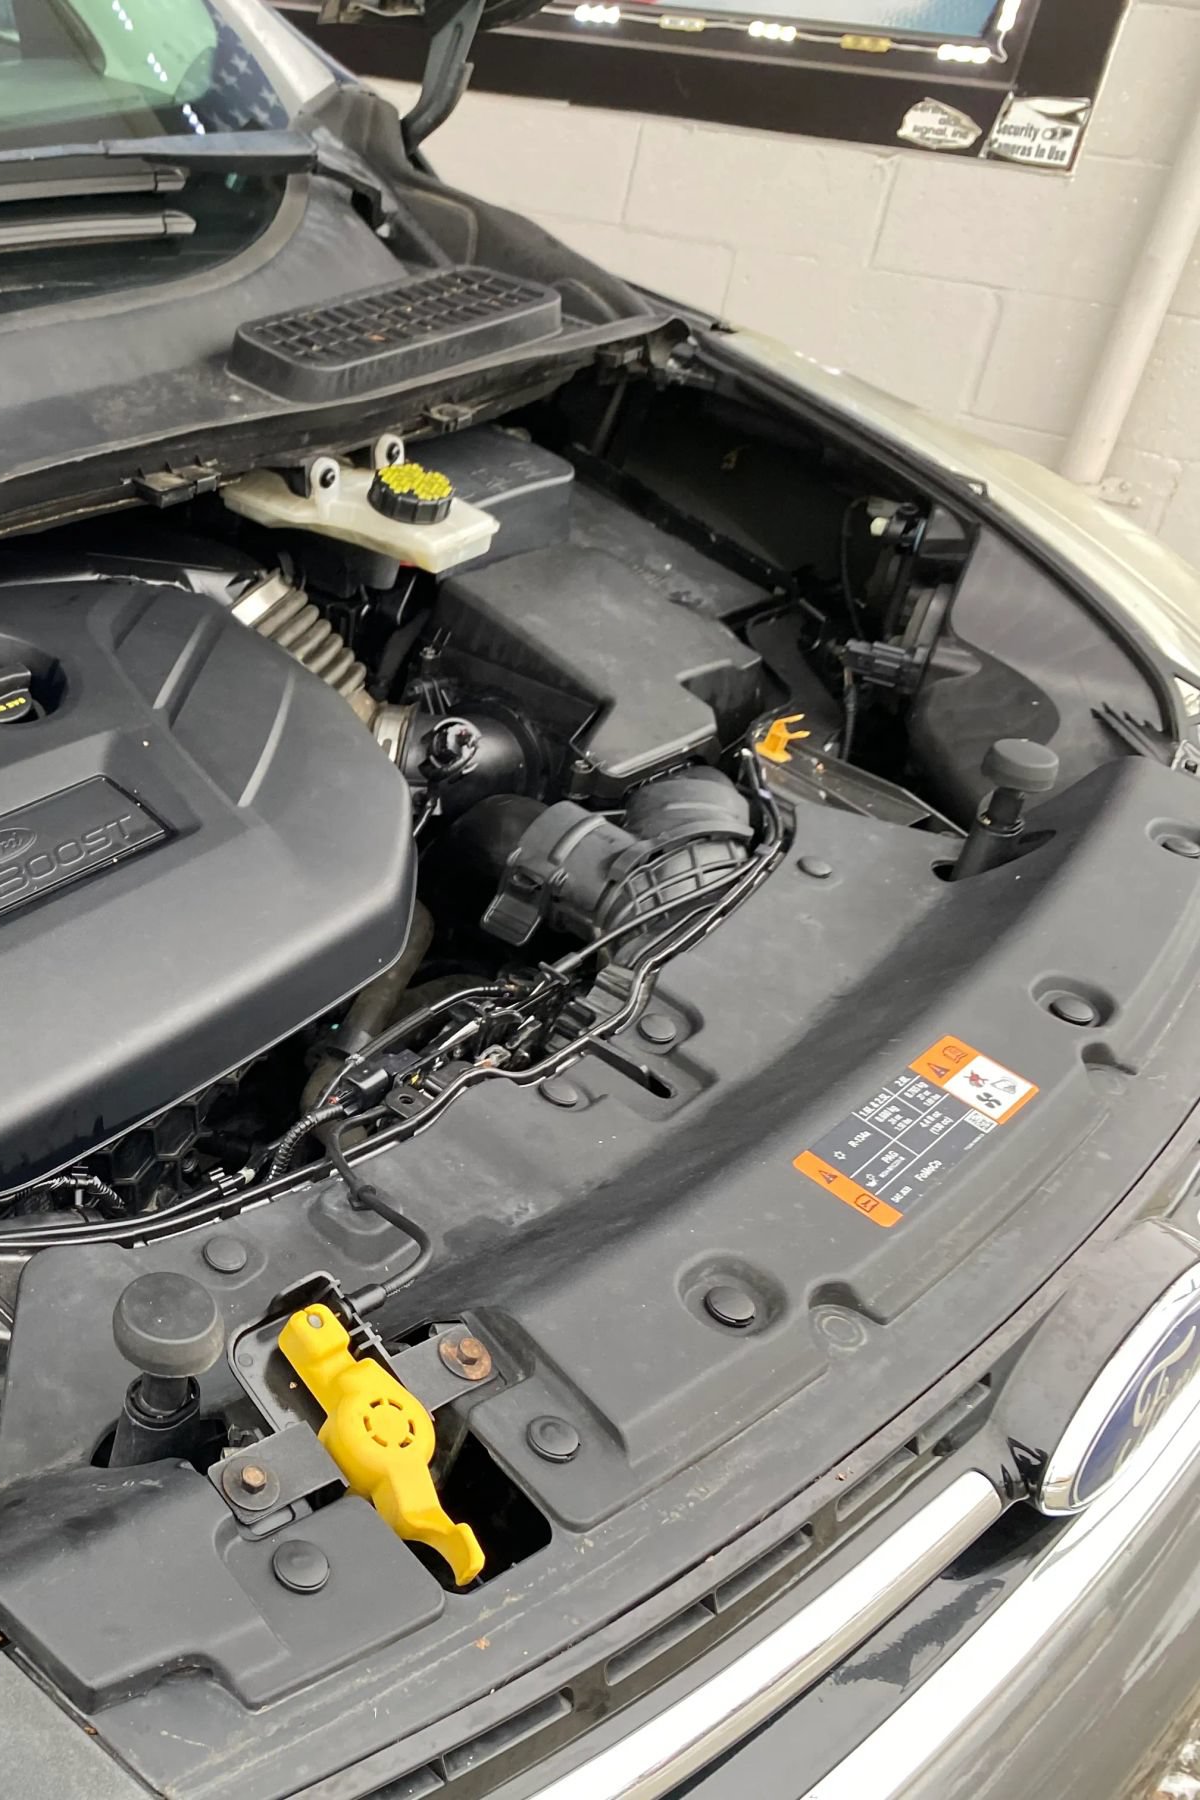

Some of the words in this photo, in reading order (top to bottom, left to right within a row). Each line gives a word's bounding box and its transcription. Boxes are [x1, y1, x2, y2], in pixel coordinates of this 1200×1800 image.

[1047, 145, 1067, 162] Use
[881, 1150, 899, 1164] PAG
[914, 1160, 943, 1182] FoMoCo
